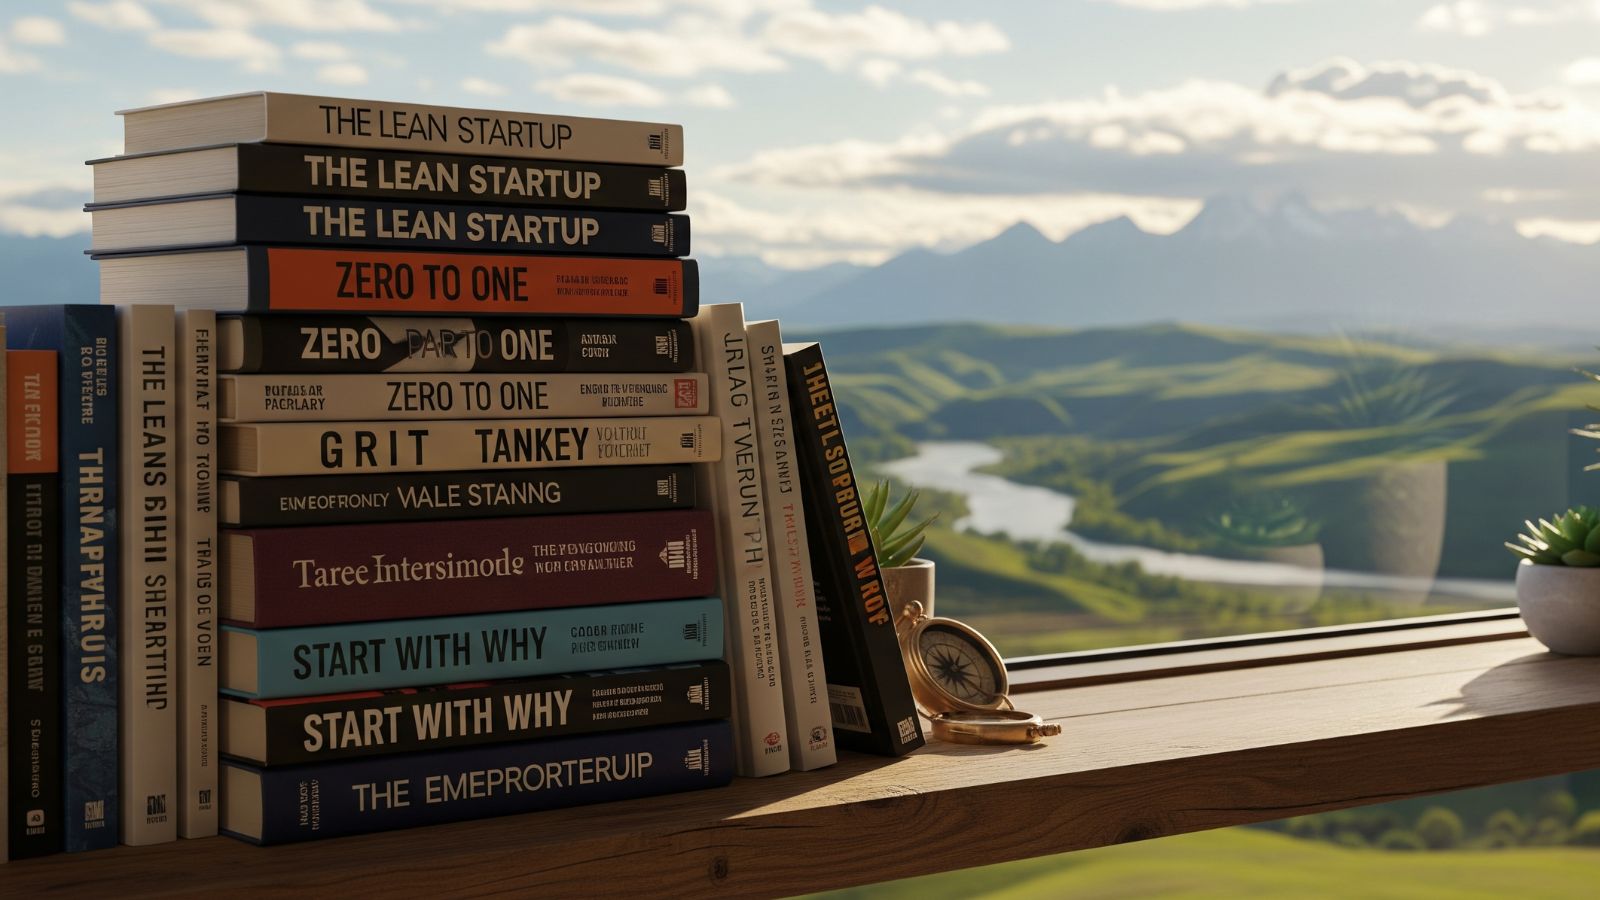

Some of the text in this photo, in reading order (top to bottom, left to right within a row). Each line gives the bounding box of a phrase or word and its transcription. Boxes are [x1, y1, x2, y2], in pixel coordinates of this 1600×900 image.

[319, 105, 572, 149] THE LEAN STARTUP
[304, 155, 601, 199] THE LEAN STARTUP
[303, 205, 600, 245] THE LEAN STARTUP
[336, 261, 414, 299] ZERO
[423, 264, 461, 300] TO
[472, 265, 528, 301] ONE
[301, 327, 382, 360] ZERO
[501, 328, 554, 360] ONE
[142, 346, 166, 390] THE
[386, 382, 453, 411] ZERO
[460, 382, 491, 410] TO
[501, 381, 549, 410] ONE
[142, 400, 167, 487] LEANS
[320, 430, 429, 468] GRIT
[475, 427, 589, 463] TANKEY
[468, 482, 561, 506] STANNG
[293, 559, 369, 588] Taree
[293, 639, 386, 679] START
[395, 632, 470, 671] WITH
[481, 626, 547, 663] WHY
[303, 706, 402, 752] START
[412, 697, 492, 741] WITH
[503, 689, 572, 731] WHY
[352, 779, 410, 811] THE
